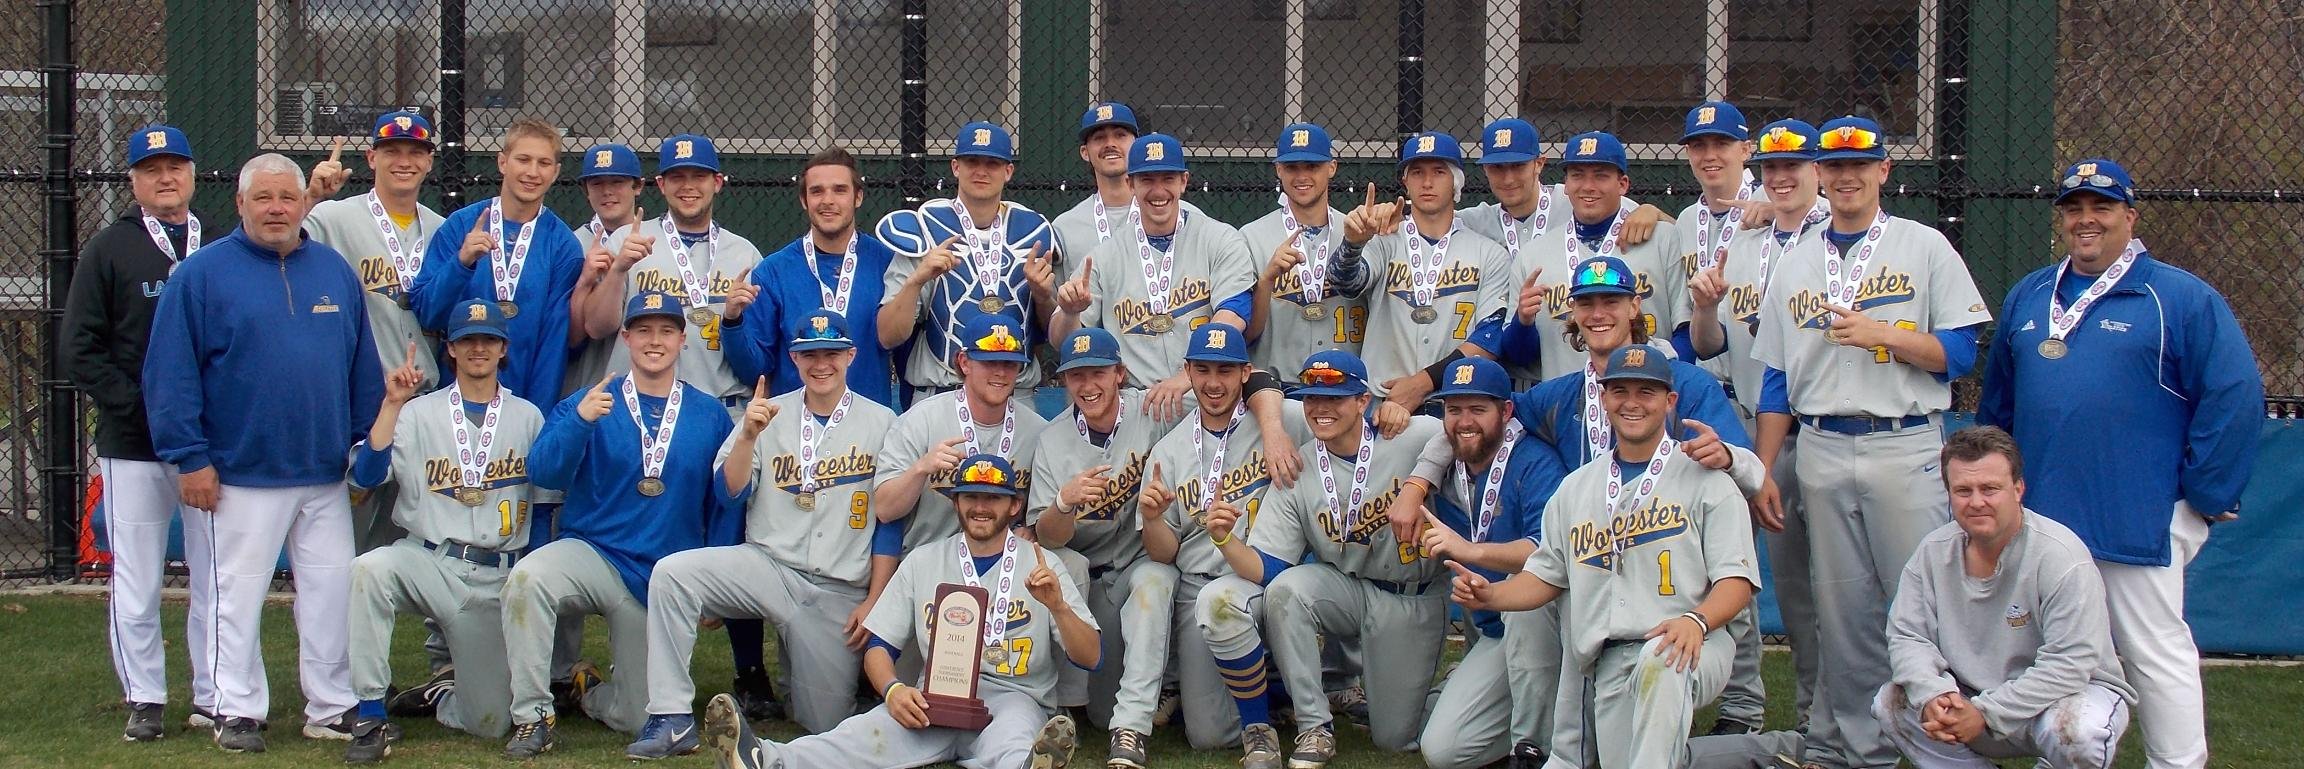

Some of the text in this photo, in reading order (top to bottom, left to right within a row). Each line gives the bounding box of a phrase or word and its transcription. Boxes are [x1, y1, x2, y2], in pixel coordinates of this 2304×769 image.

[700, 314, 720, 351] 4
[1334, 306, 1366, 343] 13
[1453, 302, 1476, 340] 7
[773, 446, 876, 484] Wocester
[849, 491, 869, 529] 9
[1658, 550, 1676, 596] 1
[947, 634, 965, 642] 2014
[996, 637, 1033, 676] 17
[932, 676, 968, 685] CHAMPIONS
